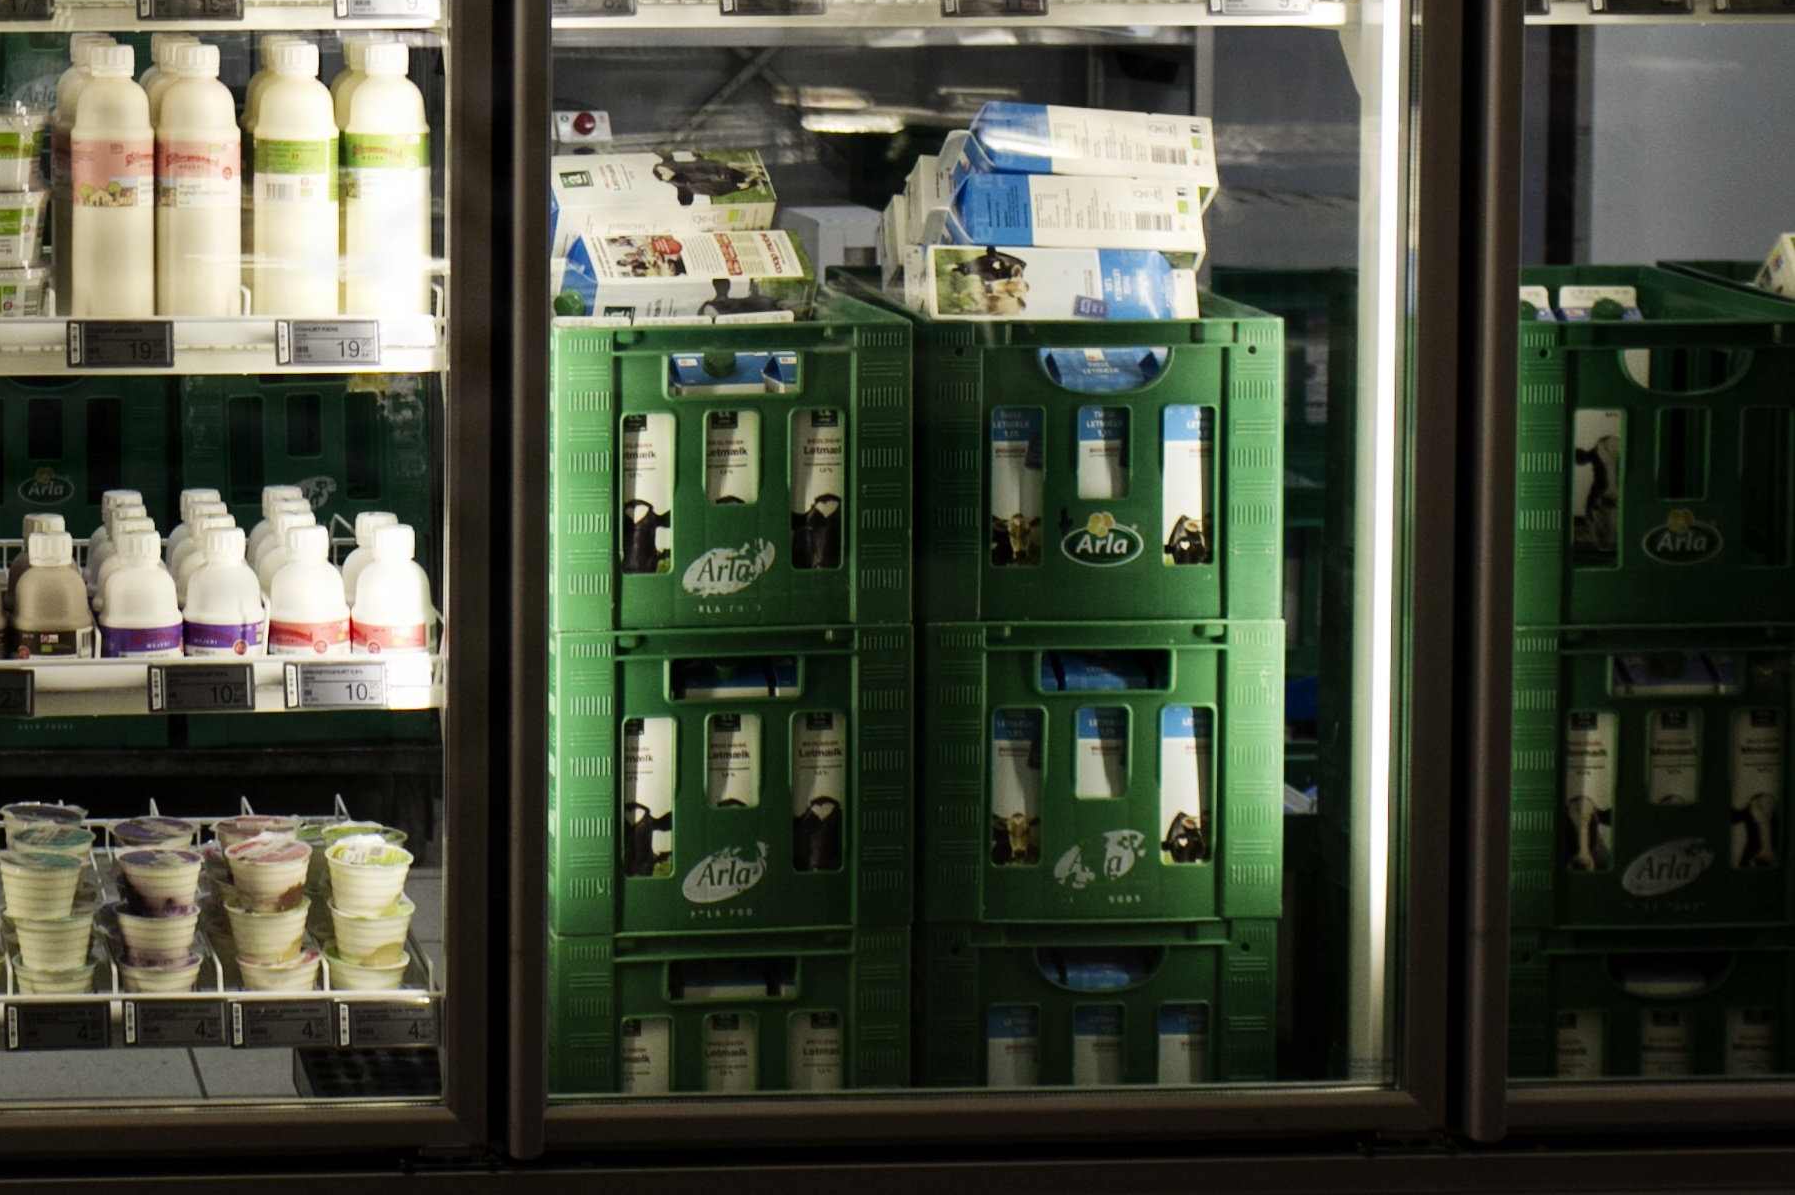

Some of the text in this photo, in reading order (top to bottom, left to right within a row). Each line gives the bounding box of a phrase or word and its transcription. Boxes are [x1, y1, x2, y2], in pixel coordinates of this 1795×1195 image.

[128, 341, 151, 360] 19
[338, 340, 360, 358] 19
[1075, 534, 1129, 554] Arla
[211, 685, 233, 703] 10
[346, 683, 368, 701] 10
